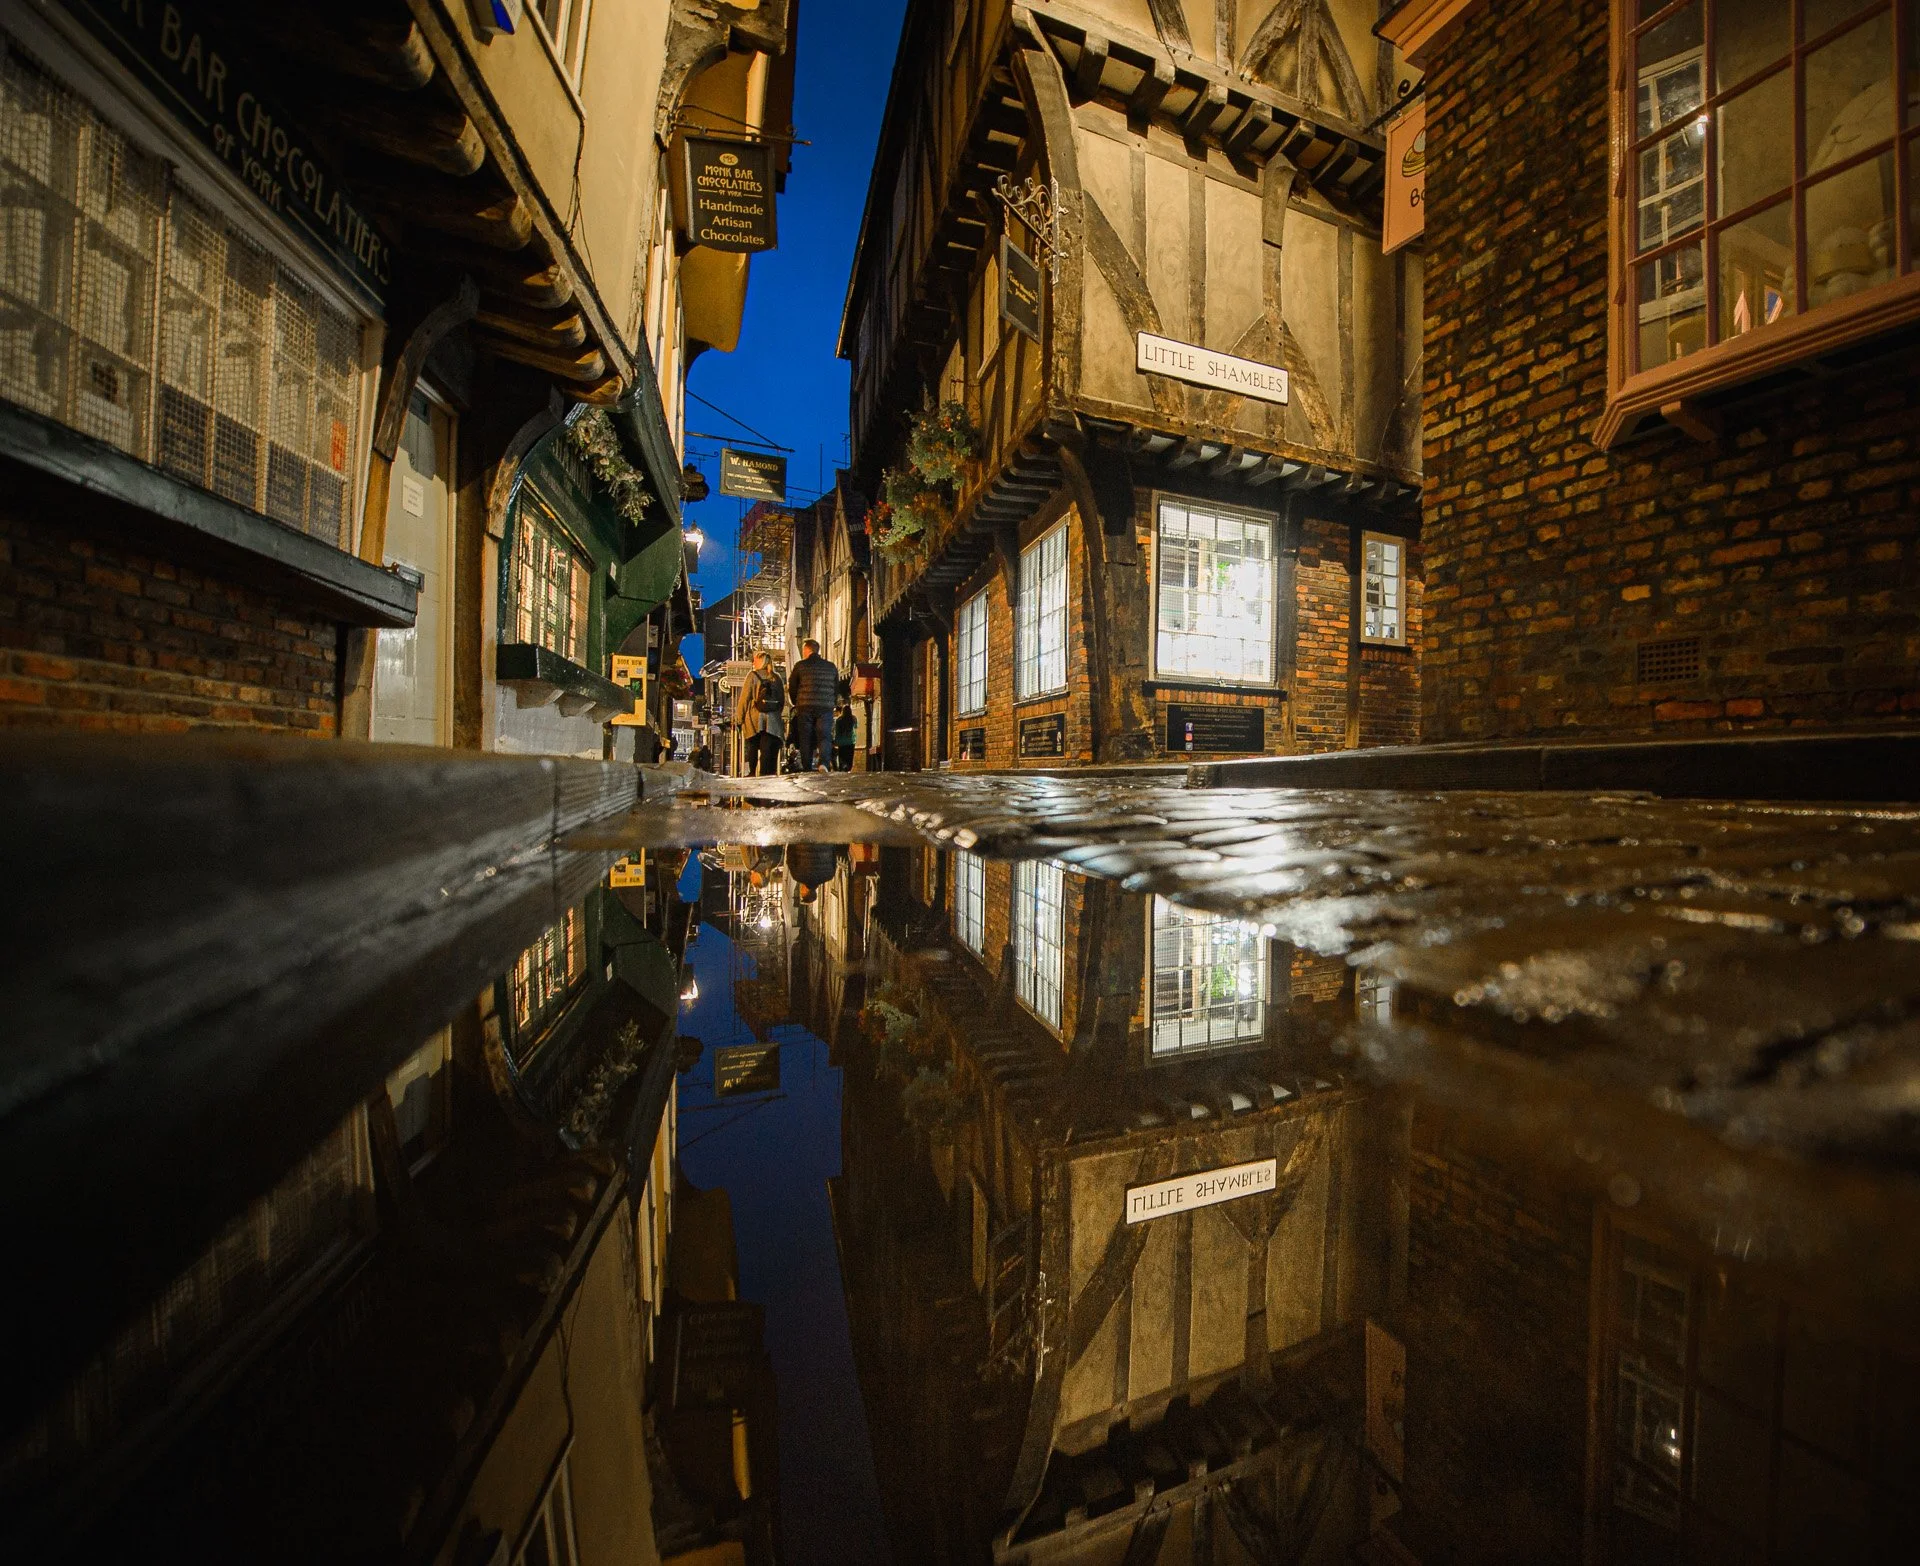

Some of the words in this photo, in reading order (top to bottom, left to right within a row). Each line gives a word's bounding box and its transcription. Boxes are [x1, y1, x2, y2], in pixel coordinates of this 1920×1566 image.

[160, 3, 228, 114] BAR
[236, 92, 392, 285] CHOCOLATIERS
[212, 123, 237, 160] OF
[240, 148, 283, 212] YORK
[705, 165, 732, 178] MONK
[734, 169, 754, 180] BAR
[697, 176, 763, 192] CHOCOLATIERS
[699, 199, 764, 215] Handmade
[712, 215, 752, 229] Artisan
[700, 228, 765, 245] Chocolates
[1145, 344, 1196, 371] LITTLE
[1207, 360, 1283, 393] SHAMBLES
[742, 459, 778, 471] HAMOND
